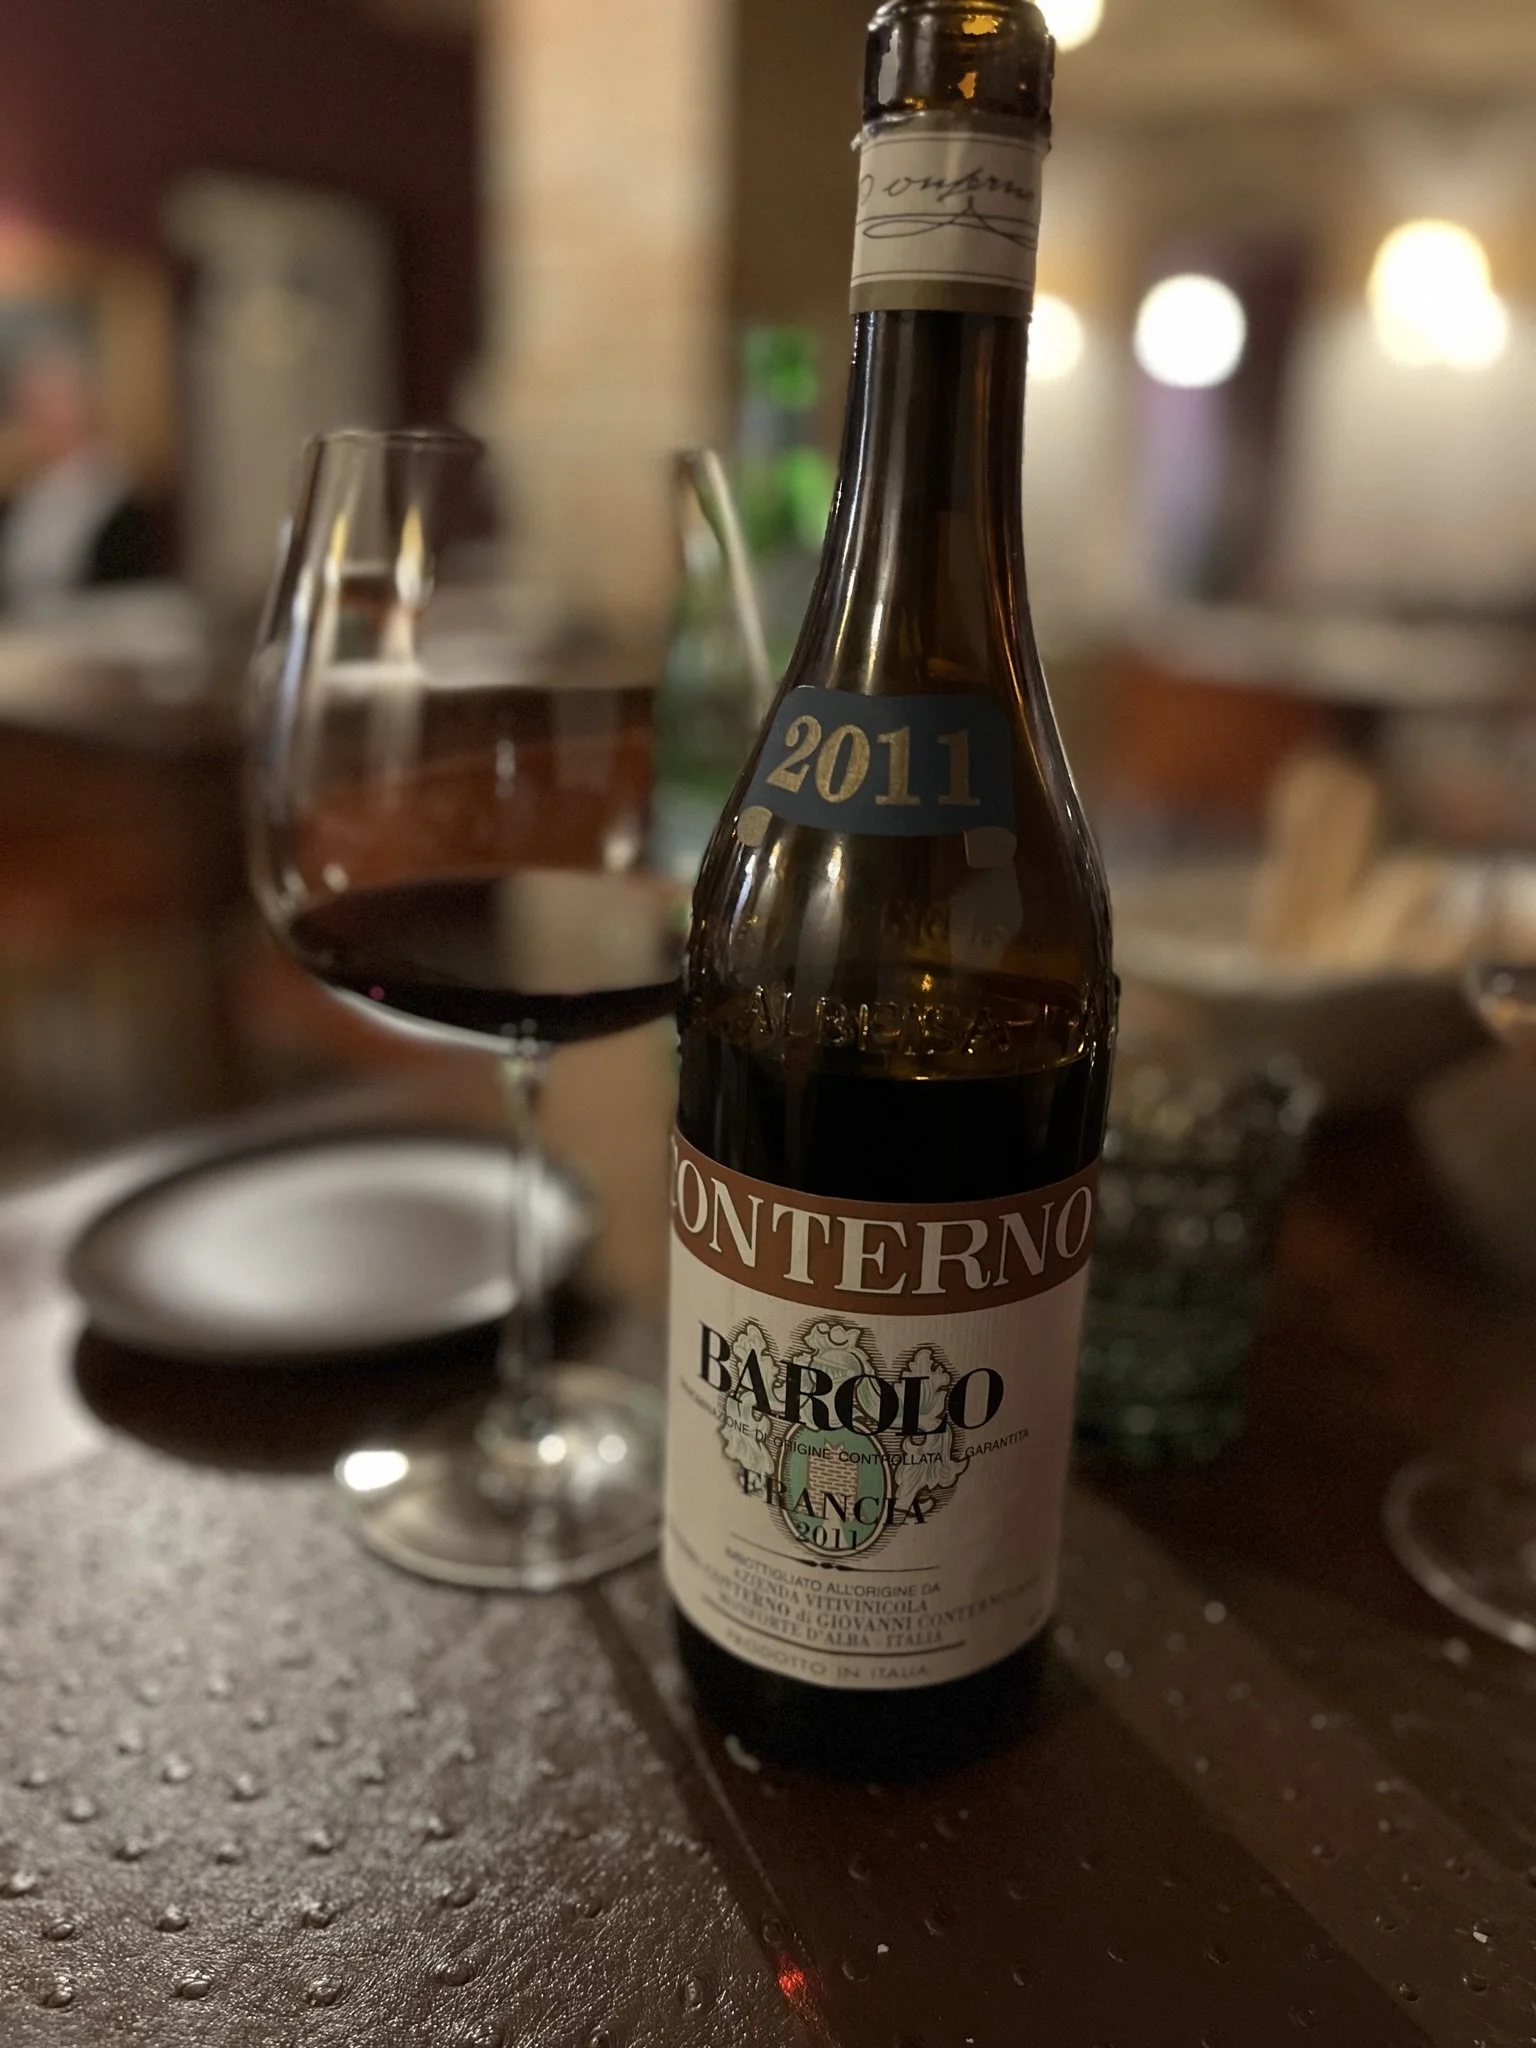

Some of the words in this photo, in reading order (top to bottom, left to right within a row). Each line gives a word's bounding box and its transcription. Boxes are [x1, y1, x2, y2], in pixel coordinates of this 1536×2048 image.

[765, 714, 981, 807] 2011
[672, 1134, 1093, 1296] ONTERNO
[698, 1319, 1005, 1437] BAROLO
[755, 1428, 768, 1445] DI
[773, 1436, 832, 1460] ORIGINE
[837, 1449, 943, 1467] CONTROLLATA
[963, 1426, 1031, 1461] GARANTITA
[740, 1467, 927, 1526] FRANCIA
[796, 1520, 858, 1551] 2011
[805, 1593, 929, 1616] VITIVINICOLA
[826, 1581, 918, 1599] ALL'ORIGINE
[921, 1582, 942, 1598] DA
[816, 1613, 913, 1634] GIOVANNI
[835, 1665, 861, 1680] IN
[870, 1663, 930, 1680] ITALIA
